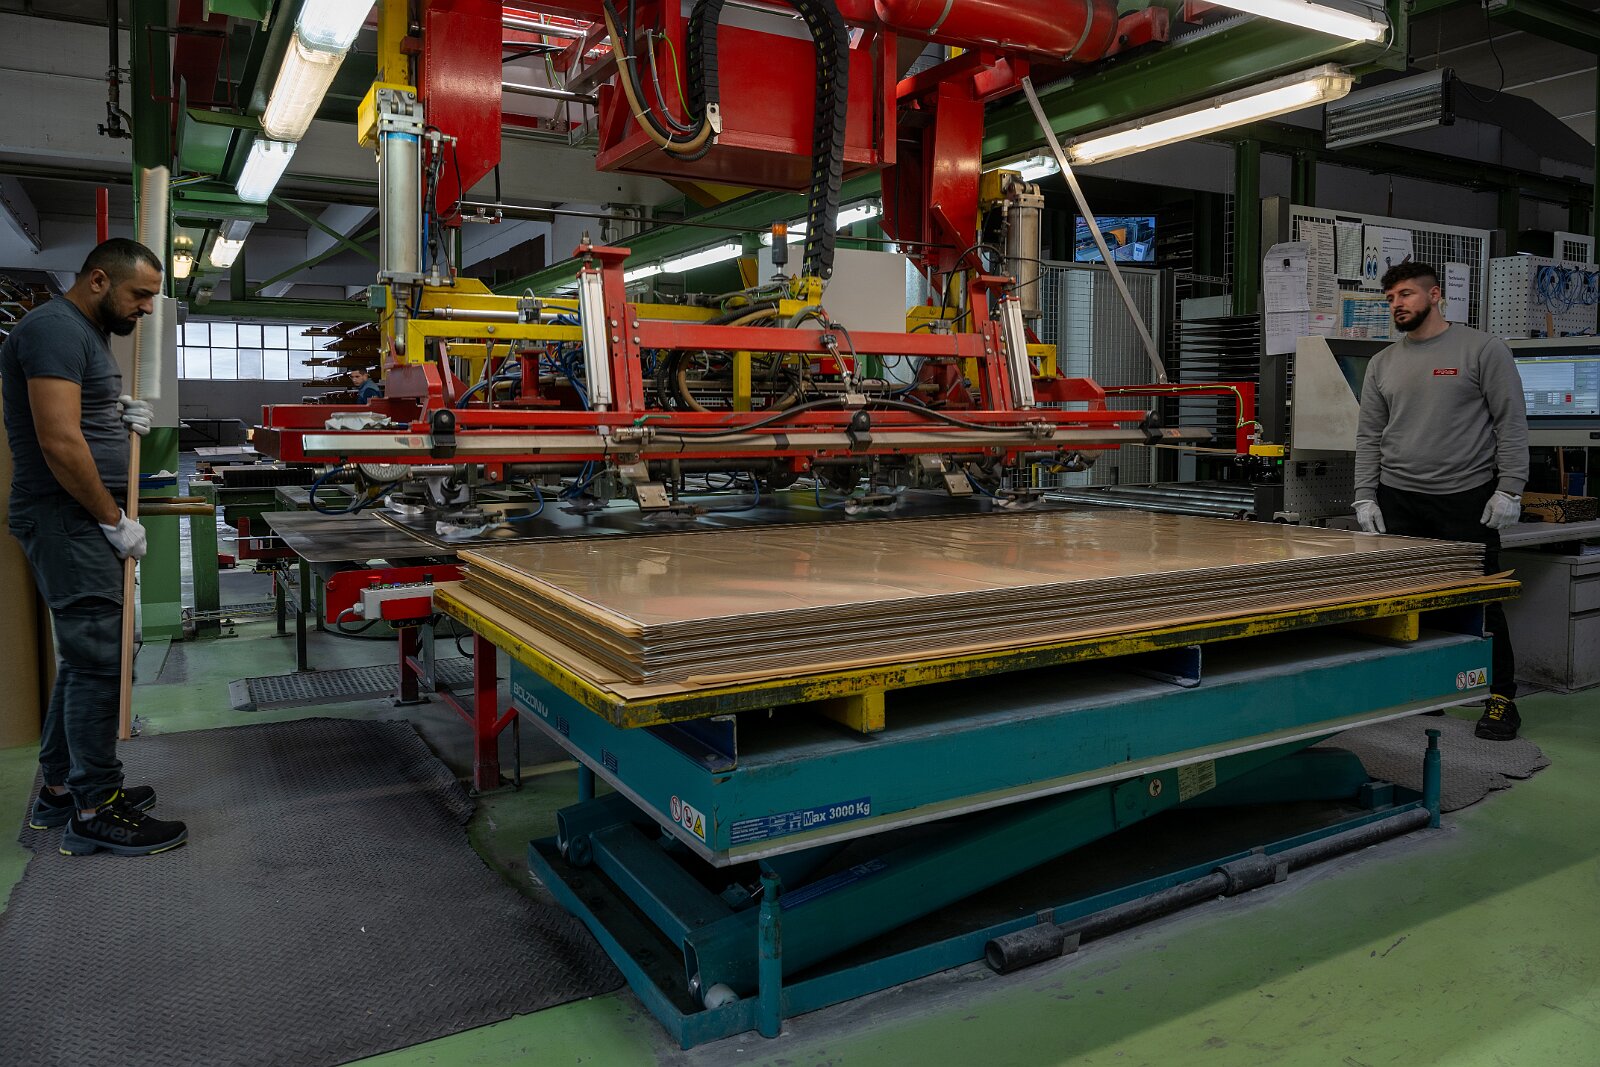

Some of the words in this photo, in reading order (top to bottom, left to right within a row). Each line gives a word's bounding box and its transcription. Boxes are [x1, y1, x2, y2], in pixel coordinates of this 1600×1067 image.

[804, 811, 826, 827] Max
[829, 804, 854, 820] 3000
[856, 801, 870, 815] Kg
[87, 820, 138, 844] uvex
